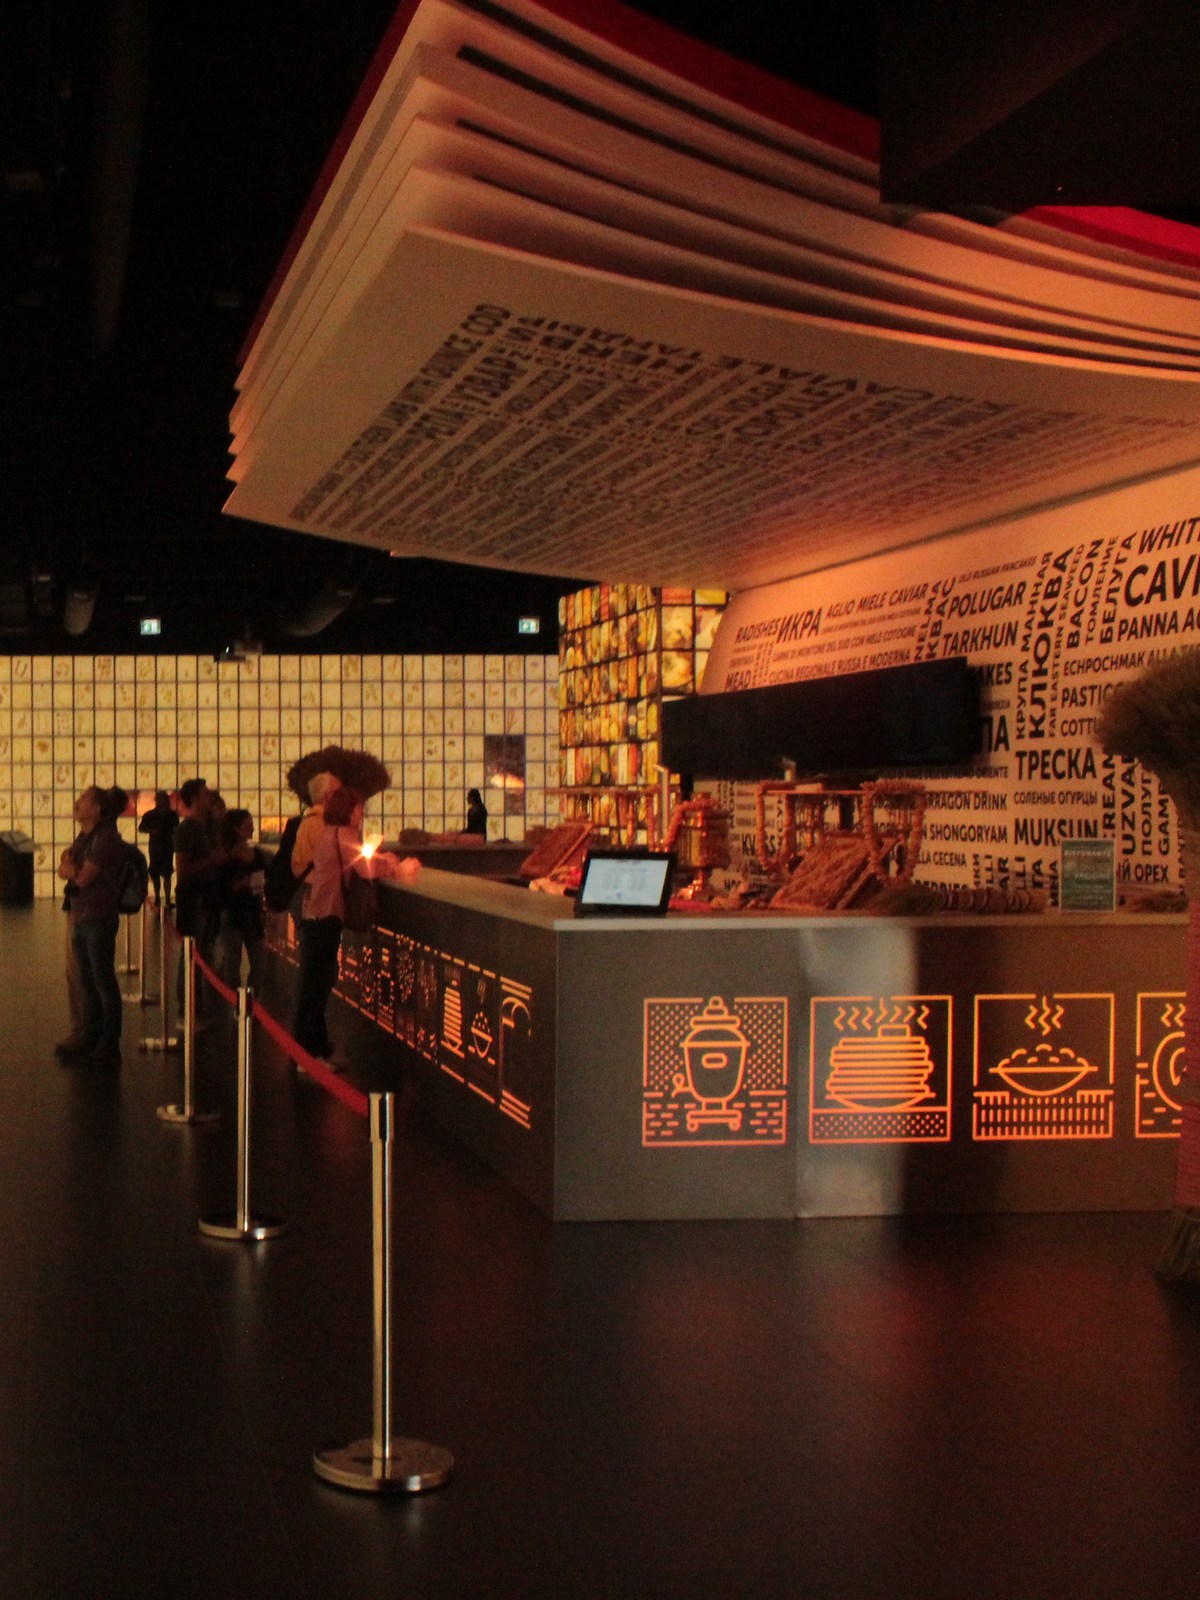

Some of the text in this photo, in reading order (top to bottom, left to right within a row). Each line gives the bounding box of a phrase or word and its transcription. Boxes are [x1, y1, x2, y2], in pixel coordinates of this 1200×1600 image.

[460, 303, 512, 337] COD
[718, 355, 936, 400] CAVIALE
[1138, 516, 1200, 555] WHIT
[825, 583, 929, 620] AGLIO MIELE CAVIAR
[948, 581, 1027, 619] POLUGAR
[1066, 538, 1104, 649] BACON
[1100, 531, 1137, 644] БЕЛУГА
[735, 618, 780, 645] RADISHES
[776, 608, 823, 643] ИКРА
[943, 620, 1019, 657] TARKHUN
[1029, 547, 1074, 739] КЛЮКВА
[1118, 609, 1178, 642] PANNA
[1063, 651, 1145, 677] ECHPOCHMAK
[1015, 747, 1097, 780] ТРЕСКА
[973, 793, 1007, 811] DRINK
[930, 823, 1008, 844] SHONGORYAM
[1134, 863, 1169, 883] ОРЕХ
